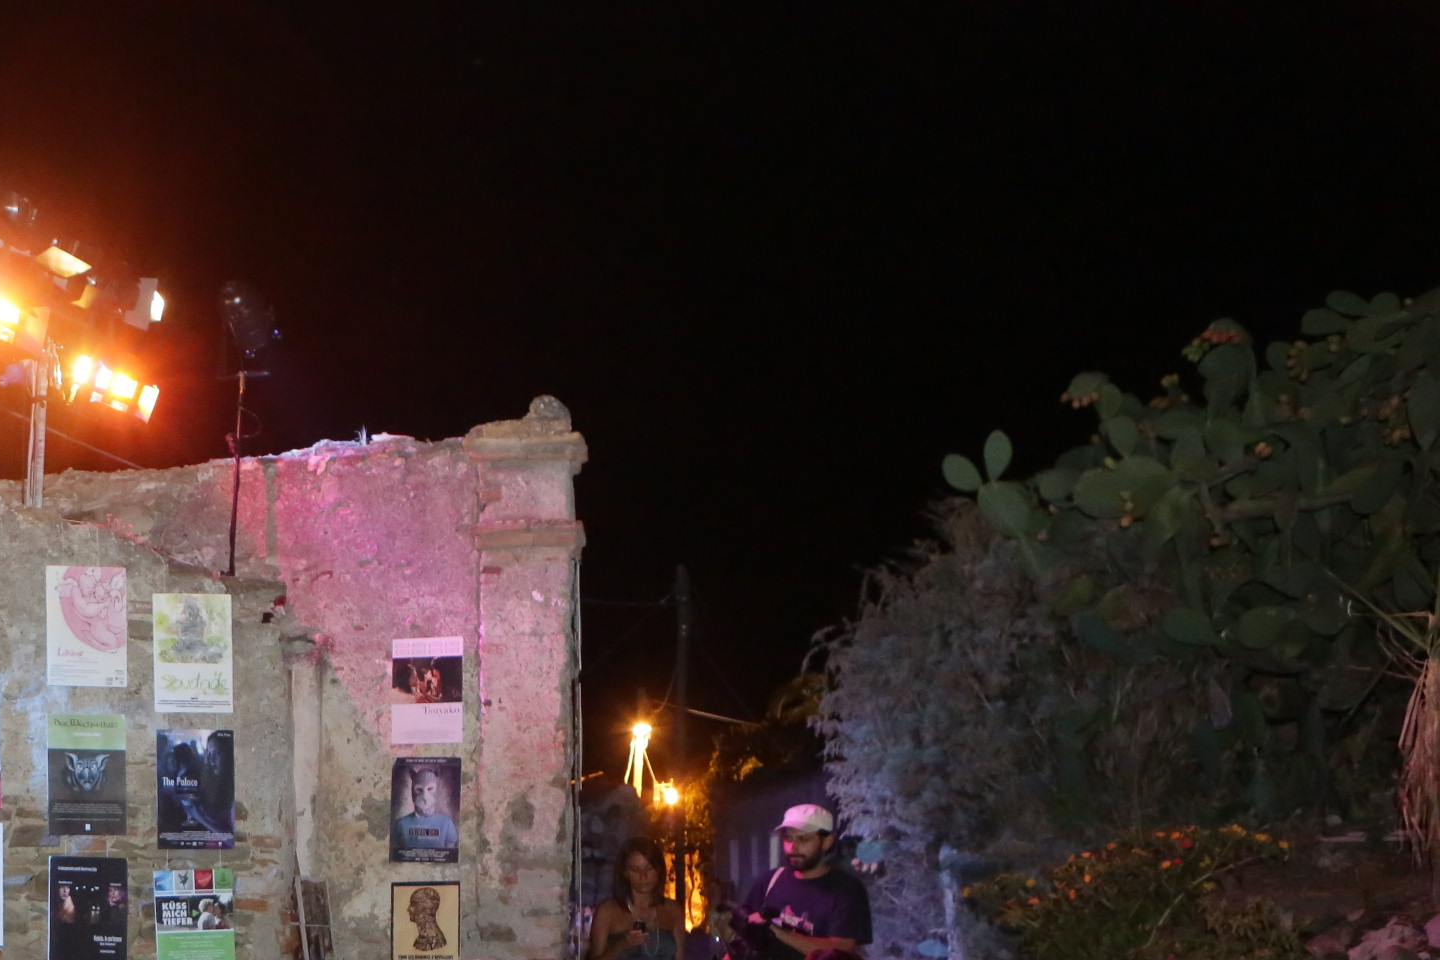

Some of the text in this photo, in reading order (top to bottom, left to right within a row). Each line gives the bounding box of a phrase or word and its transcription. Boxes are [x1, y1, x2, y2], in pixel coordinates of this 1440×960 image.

[162, 776, 199, 787] The Palace
[161, 901, 187, 910] KÜSS
[162, 910, 187, 918] MICH
[162, 917, 193, 926] TIEFER
